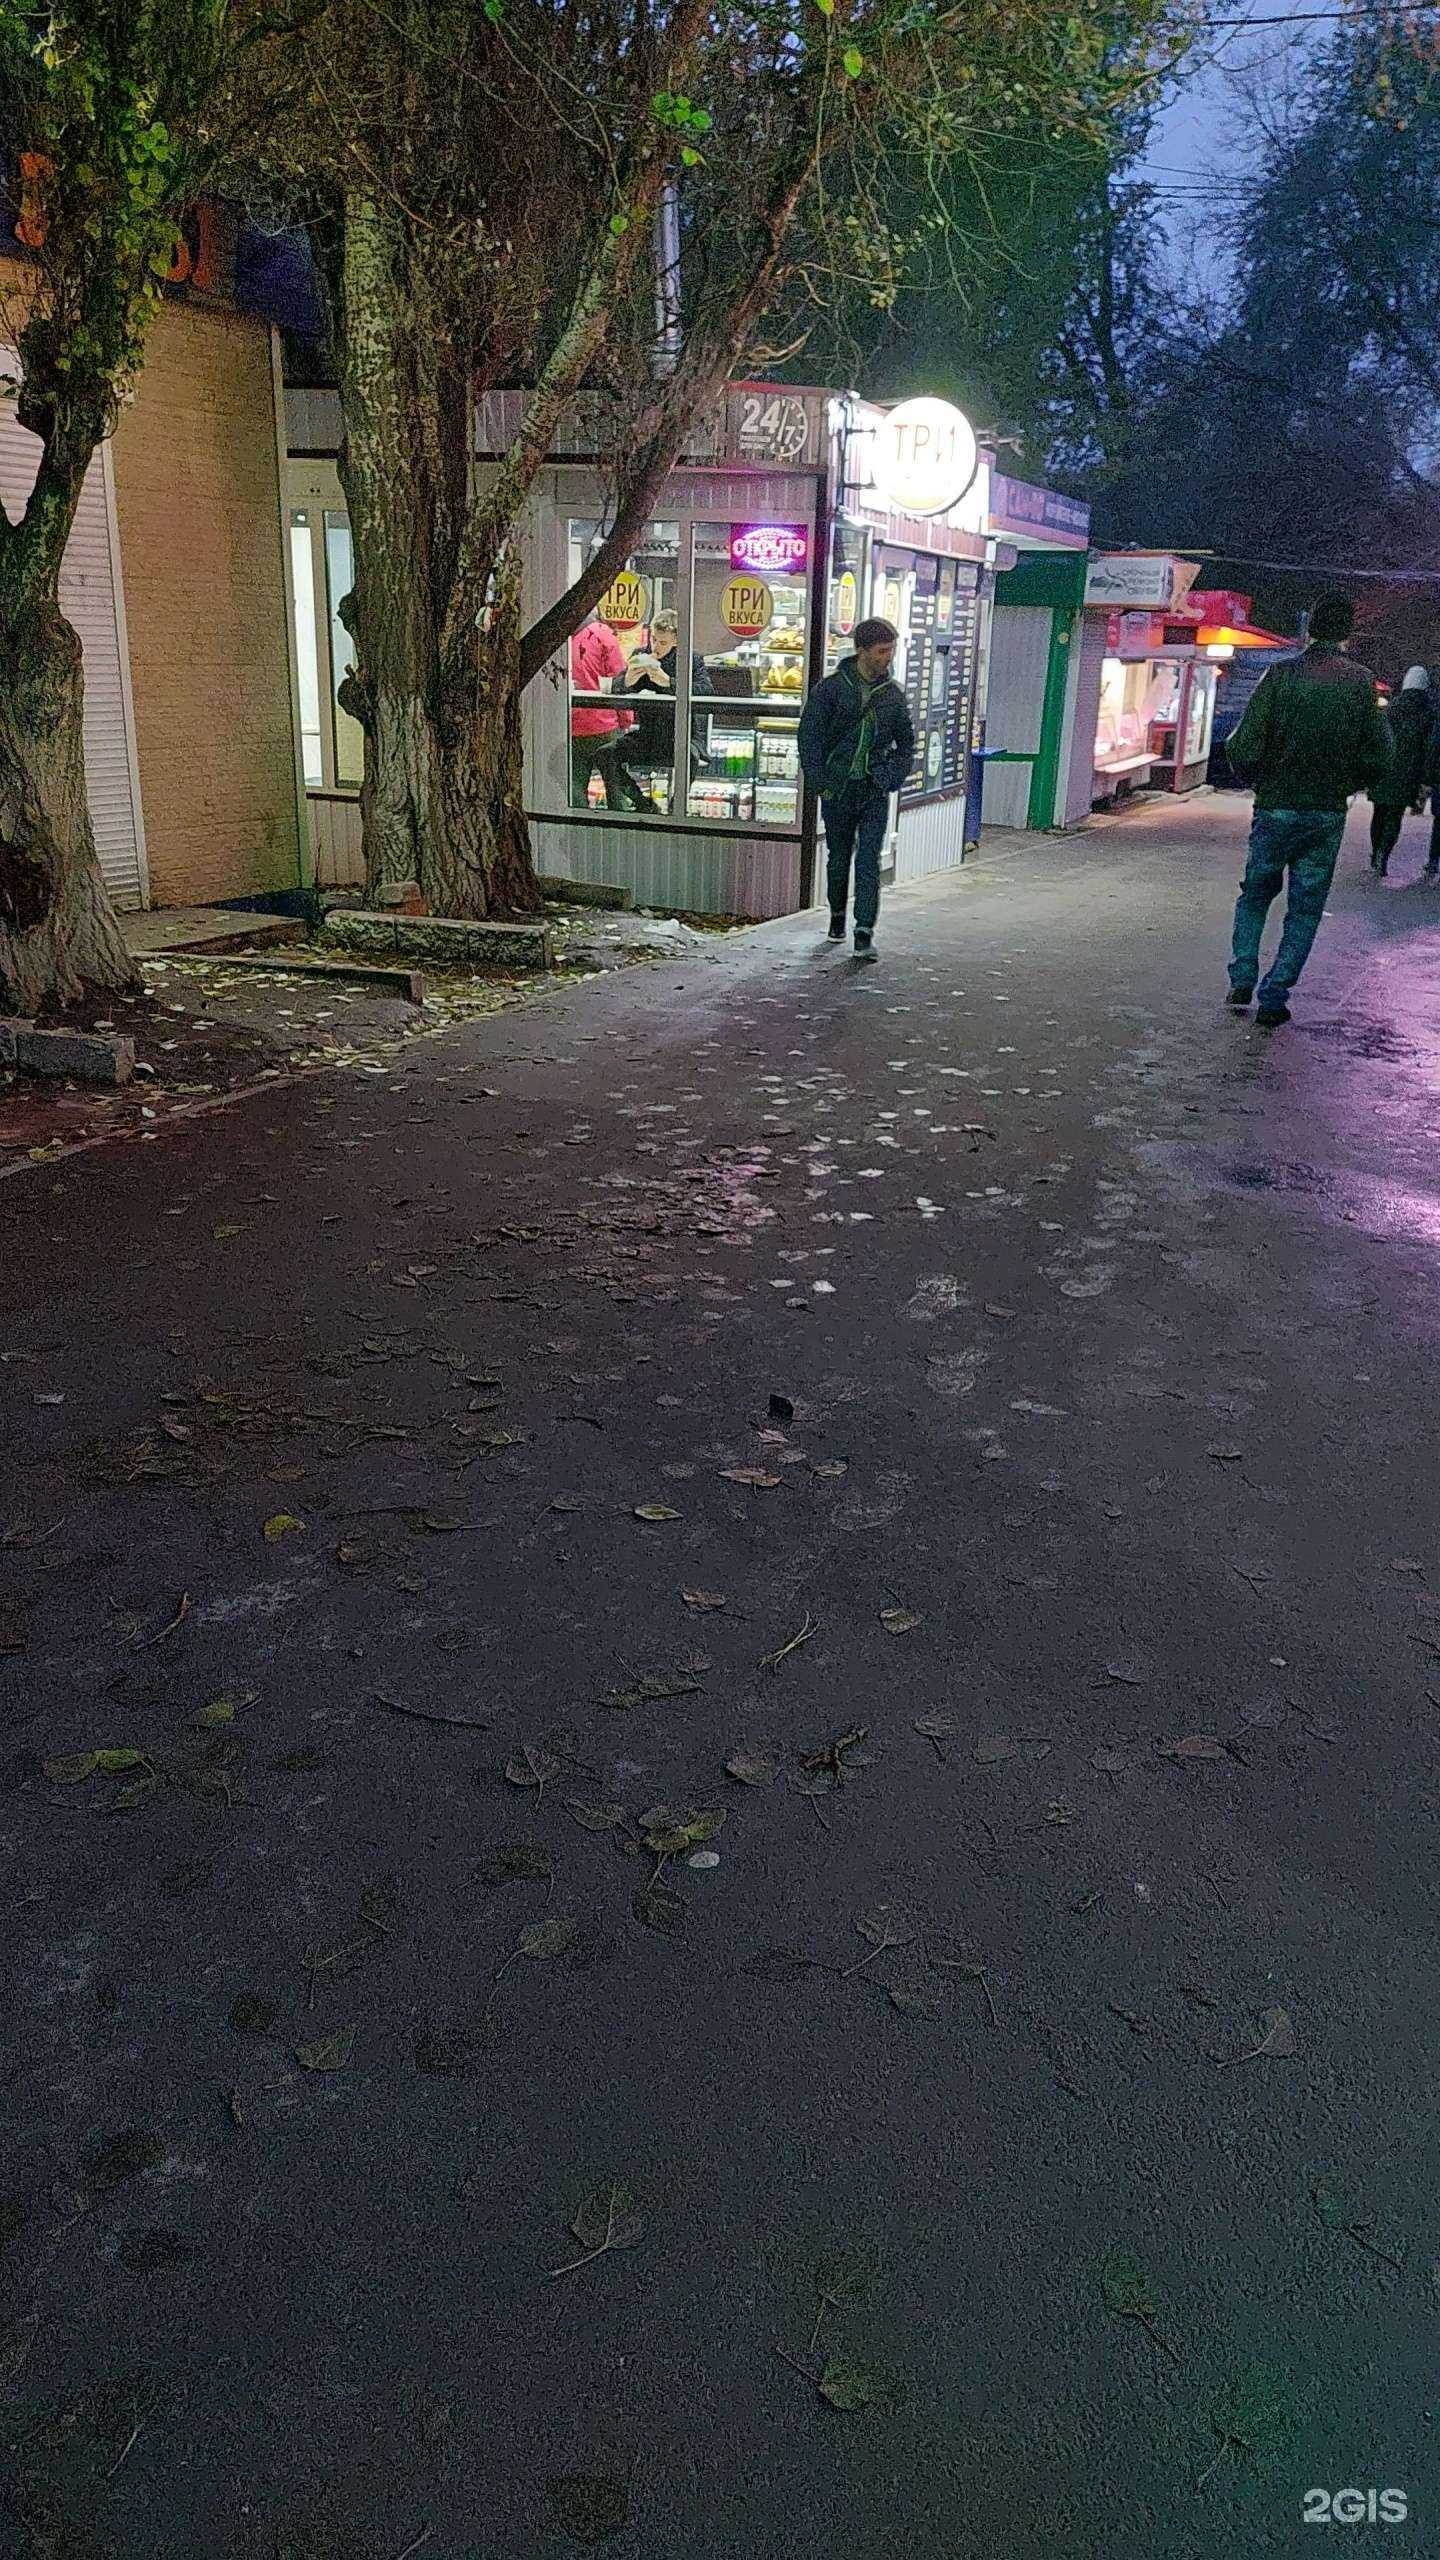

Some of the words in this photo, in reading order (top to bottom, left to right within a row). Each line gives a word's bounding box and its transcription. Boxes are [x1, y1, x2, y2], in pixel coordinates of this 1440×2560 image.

[732, 538, 806, 558] ОТКРЫТО
[729, 587, 764, 610] ТРИ
[605, 605, 639, 619] ВКУСА
[729, 611, 764, 625] ВКУСА
